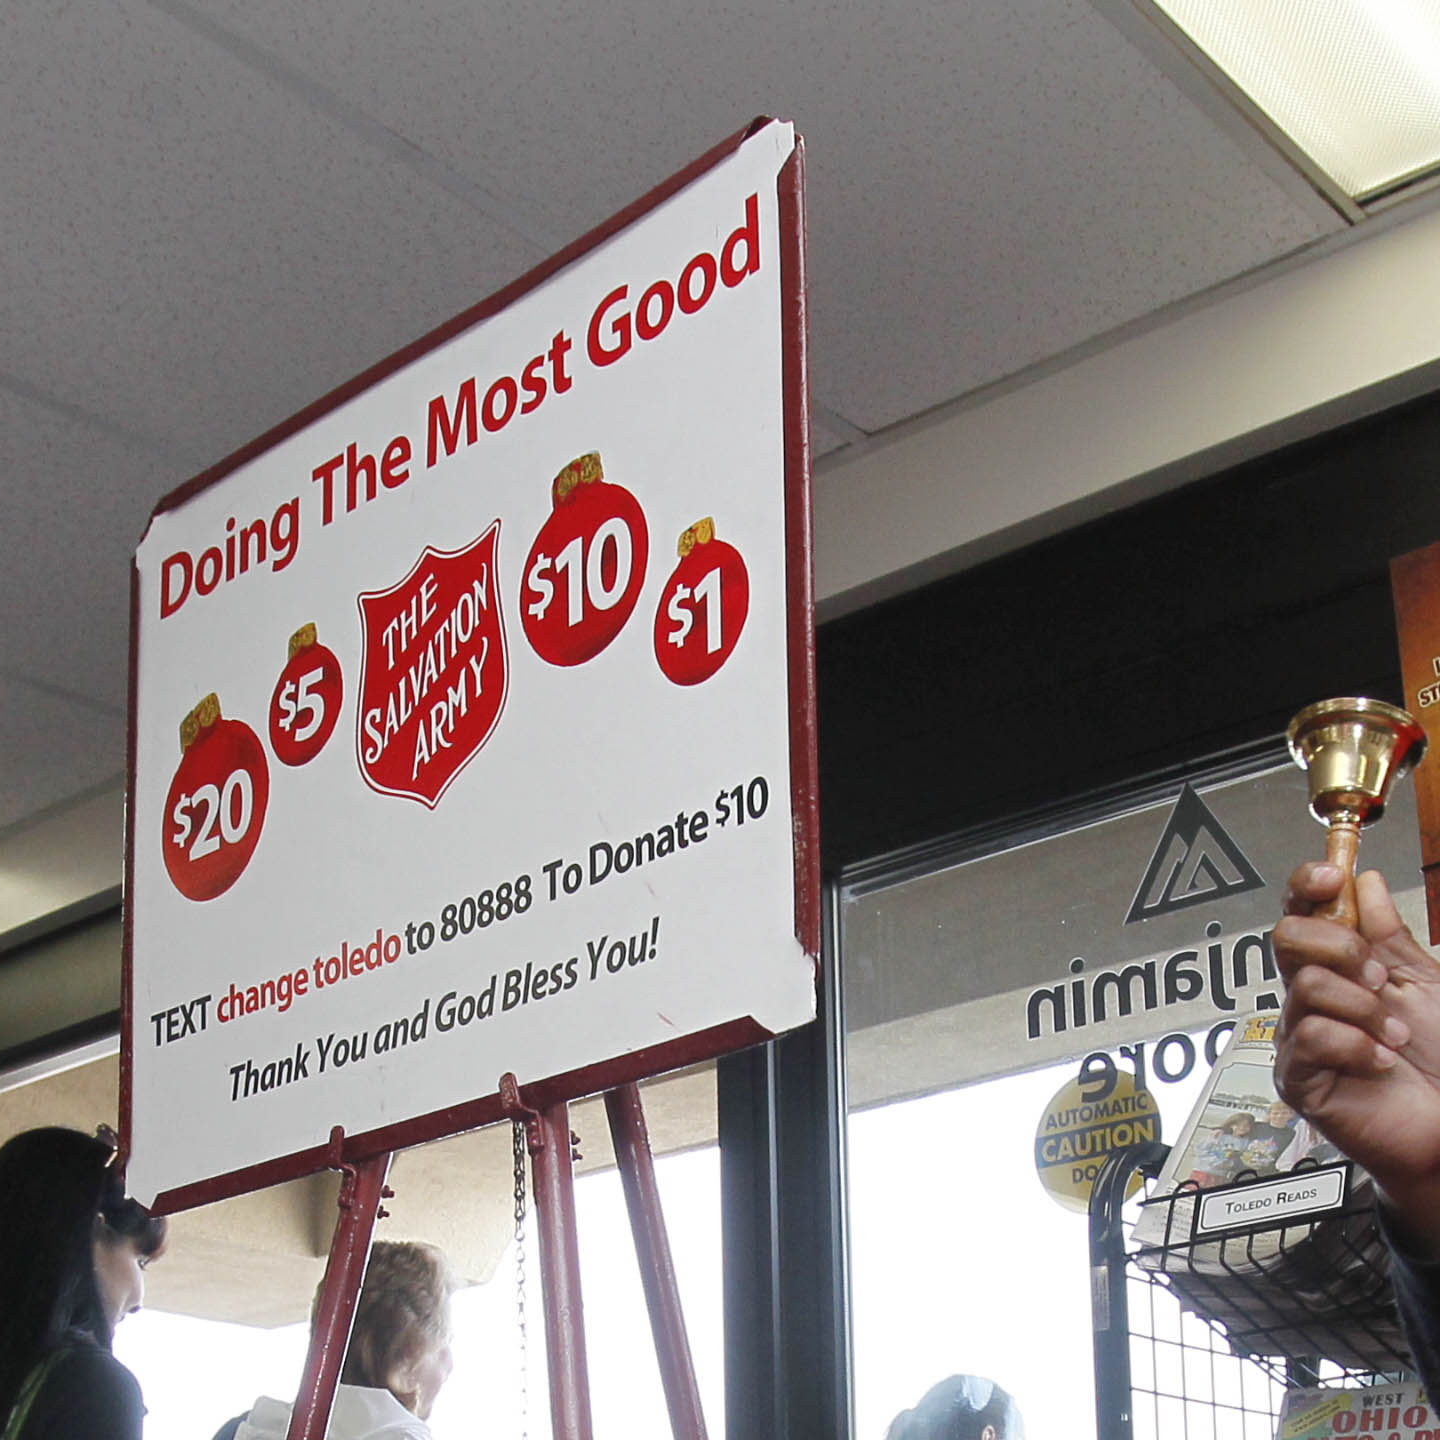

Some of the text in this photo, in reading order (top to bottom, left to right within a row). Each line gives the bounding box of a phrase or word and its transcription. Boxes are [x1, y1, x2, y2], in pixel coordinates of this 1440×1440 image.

[161, 192, 761, 620] Doing The Most Good
[527, 516, 633, 628] $10
[667, 566, 723, 655] $1
[364, 562, 488, 764] SALVATION
[383, 573, 439, 671] THE
[279, 667, 324, 743] $5
[412, 636, 488, 781] ARMY
[172, 767, 254, 862] $20
[150, 775, 770, 1047] TEXT change toledo to 80888 To Donate $10
[229, 915, 661, 1102] Thank You and God Bless You!
[1041, 1117, 1155, 1162] CAUTION
[1046, 1091, 1148, 1131] AUTOMATIC
[1332, 1404, 1428, 1435] OHIO
[1362, 1392, 1405, 1408] WEST
